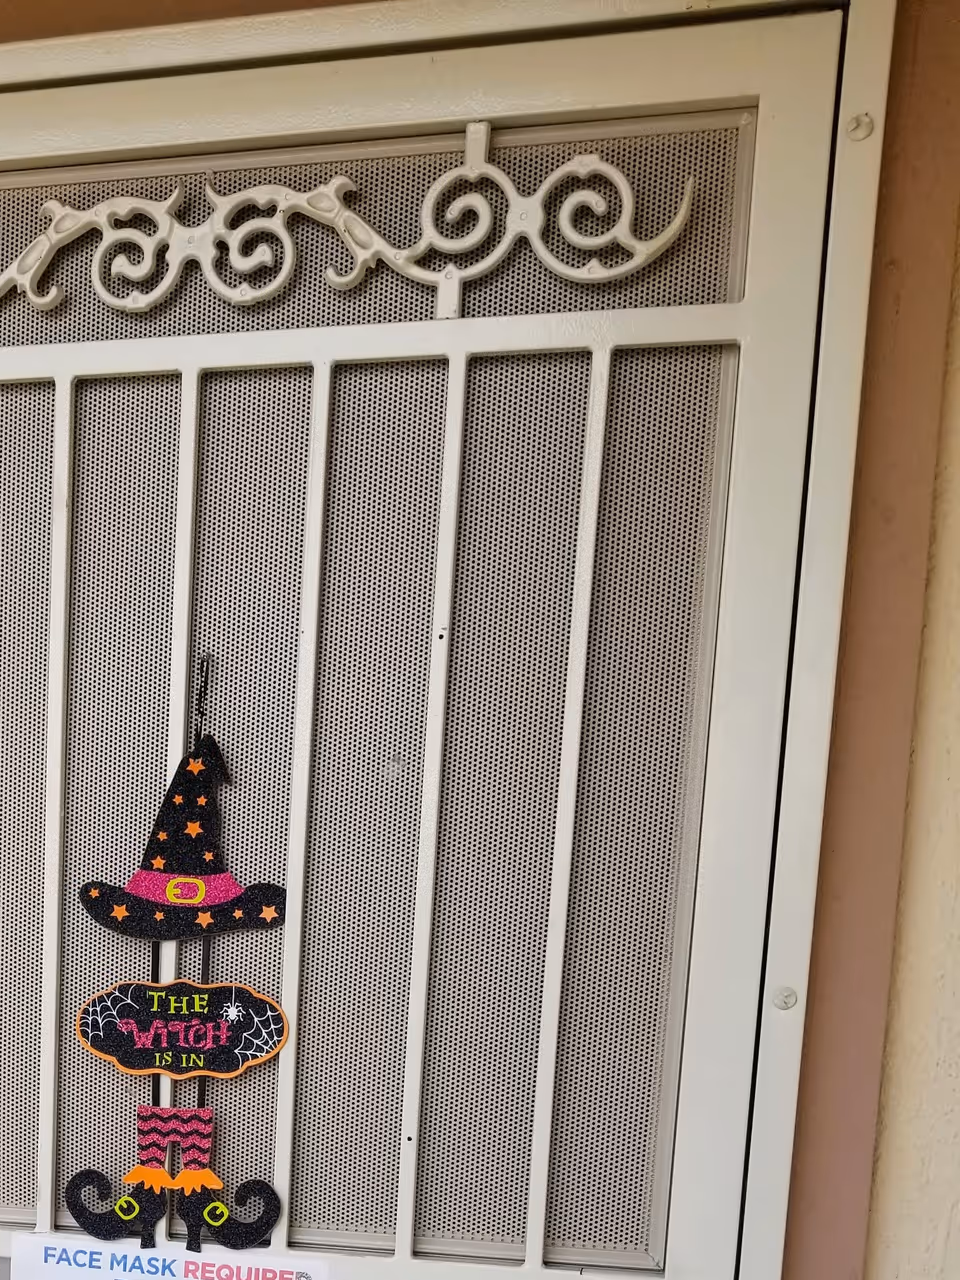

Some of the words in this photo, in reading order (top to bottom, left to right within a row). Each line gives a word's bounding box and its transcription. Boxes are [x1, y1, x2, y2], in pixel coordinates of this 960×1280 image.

[147, 991, 209, 1014] THE
[117, 1018, 232, 1050] WITCH
[155, 1051, 172, 1067] IS
[180, 1053, 205, 1067] IN
[43, 1246, 102, 1270] FACE
[110, 1253, 177, 1277] MASK
